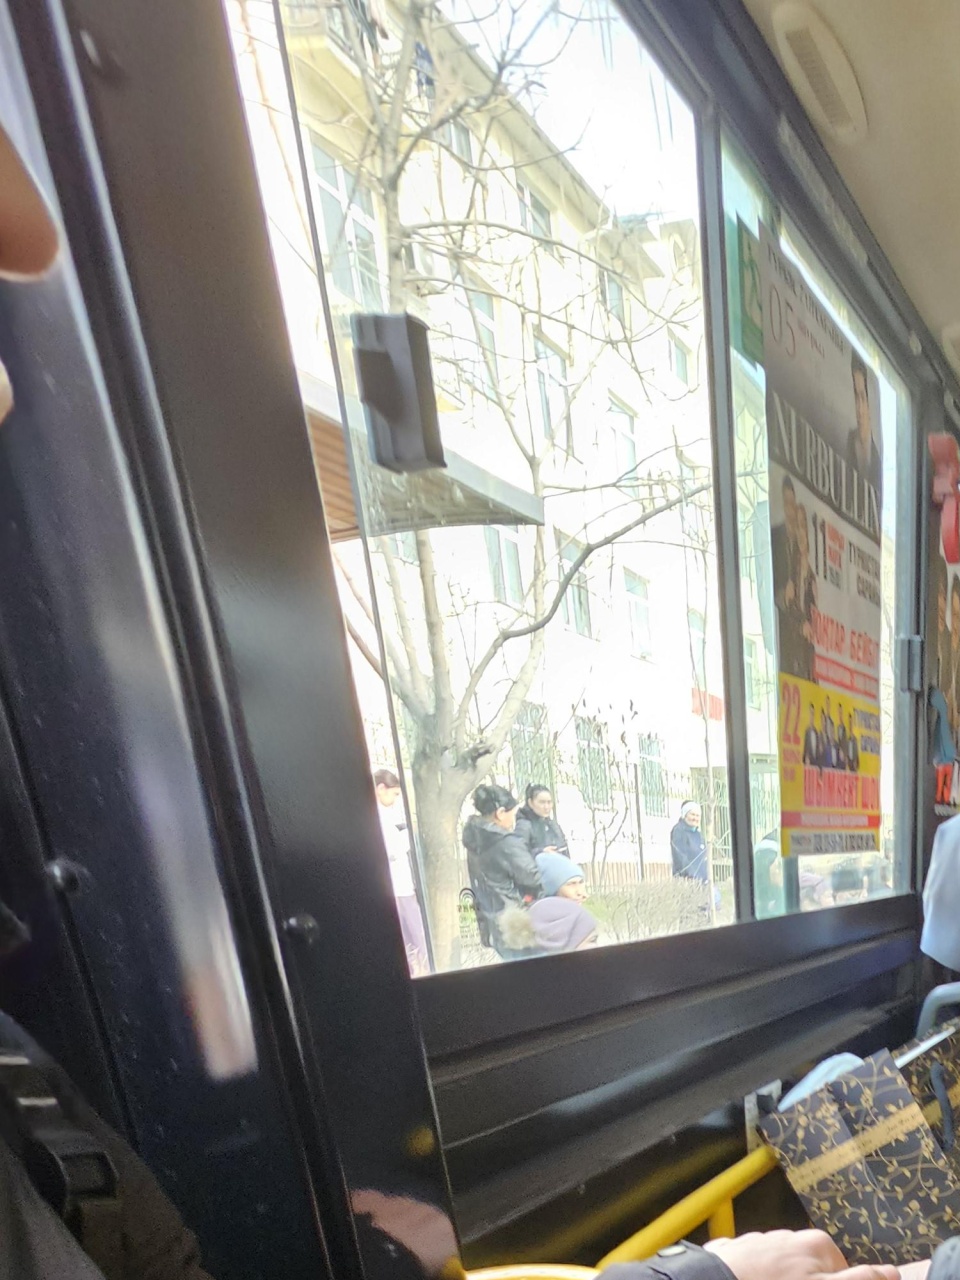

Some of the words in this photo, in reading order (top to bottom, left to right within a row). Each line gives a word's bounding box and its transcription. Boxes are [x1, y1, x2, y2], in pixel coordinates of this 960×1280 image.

[769, 284, 796, 358] 05
[771, 389, 880, 541] NURBULLIN
[812, 511, 828, 581] 11
[782, 679, 801, 745] 22
